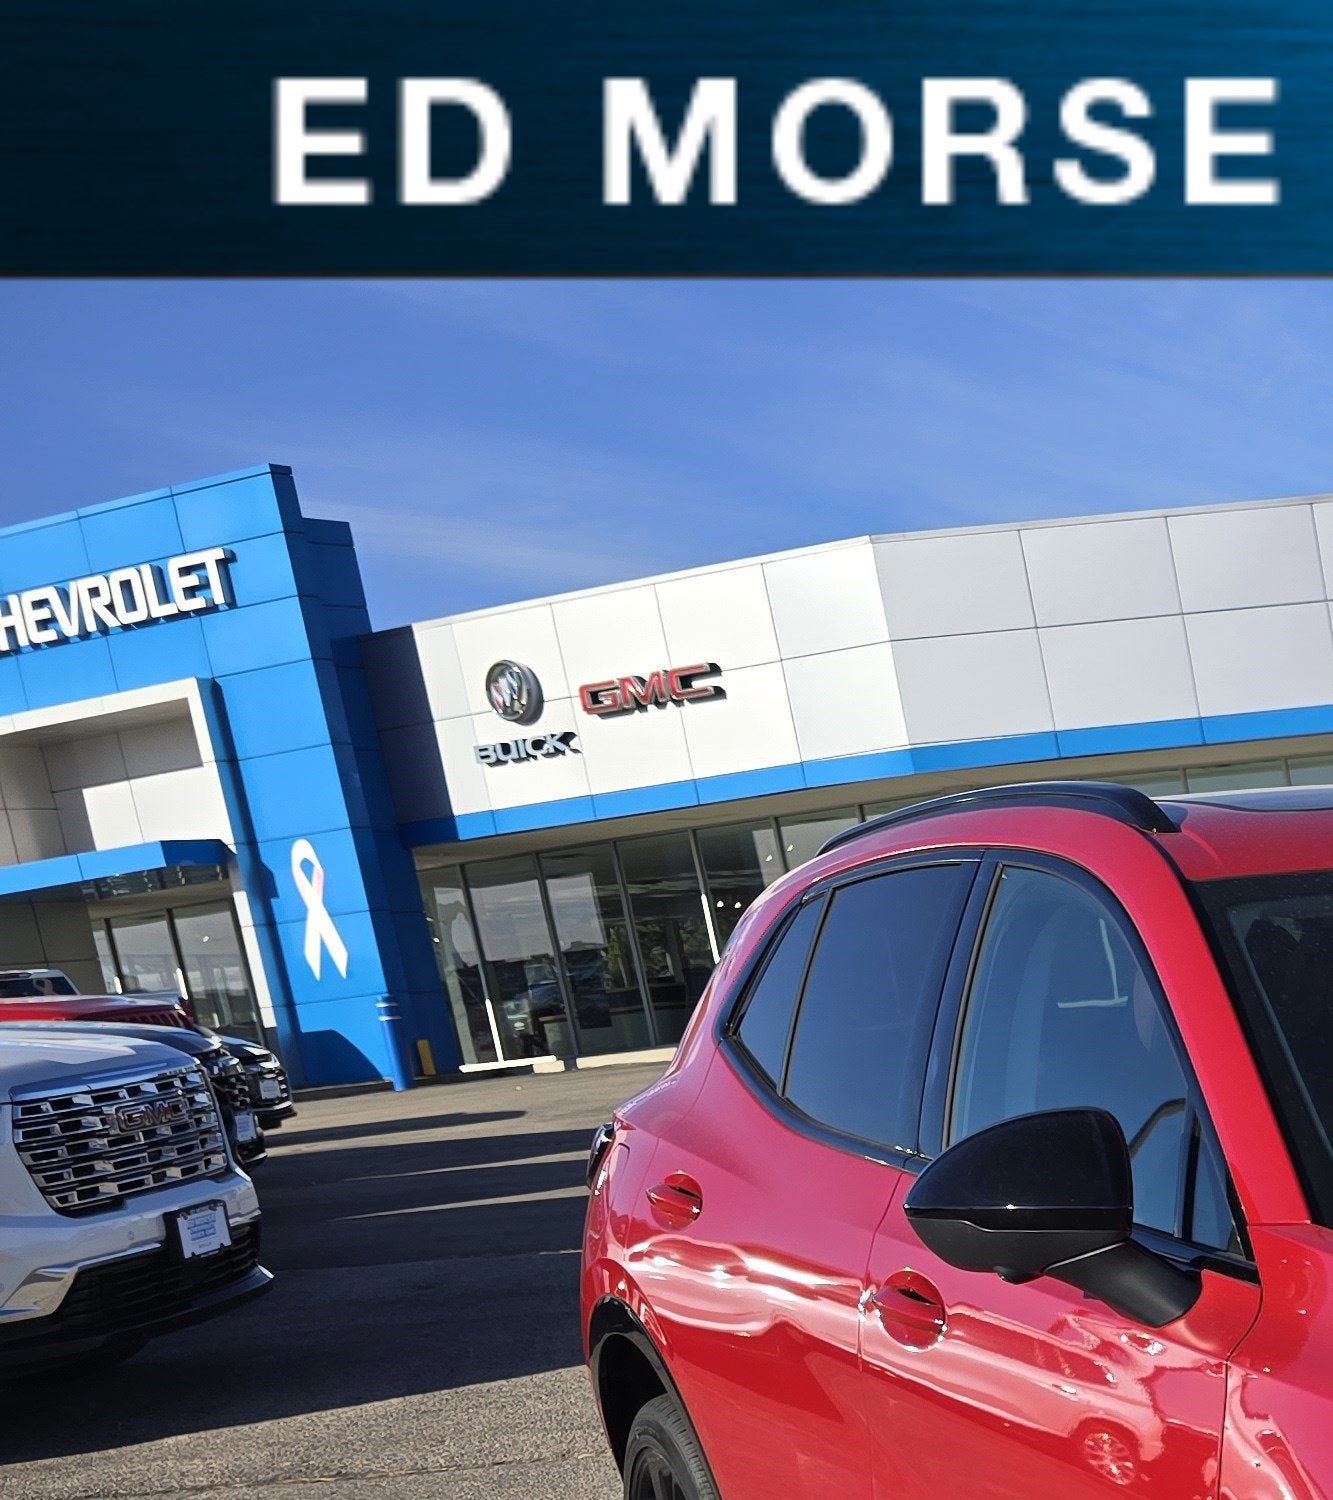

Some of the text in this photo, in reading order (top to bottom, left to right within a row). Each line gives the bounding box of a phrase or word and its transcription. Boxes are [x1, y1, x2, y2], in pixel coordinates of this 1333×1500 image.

[578, 662, 717, 715] GMC
[473, 732, 572, 765] BUICK
[117, 1097, 188, 1130] GMC
